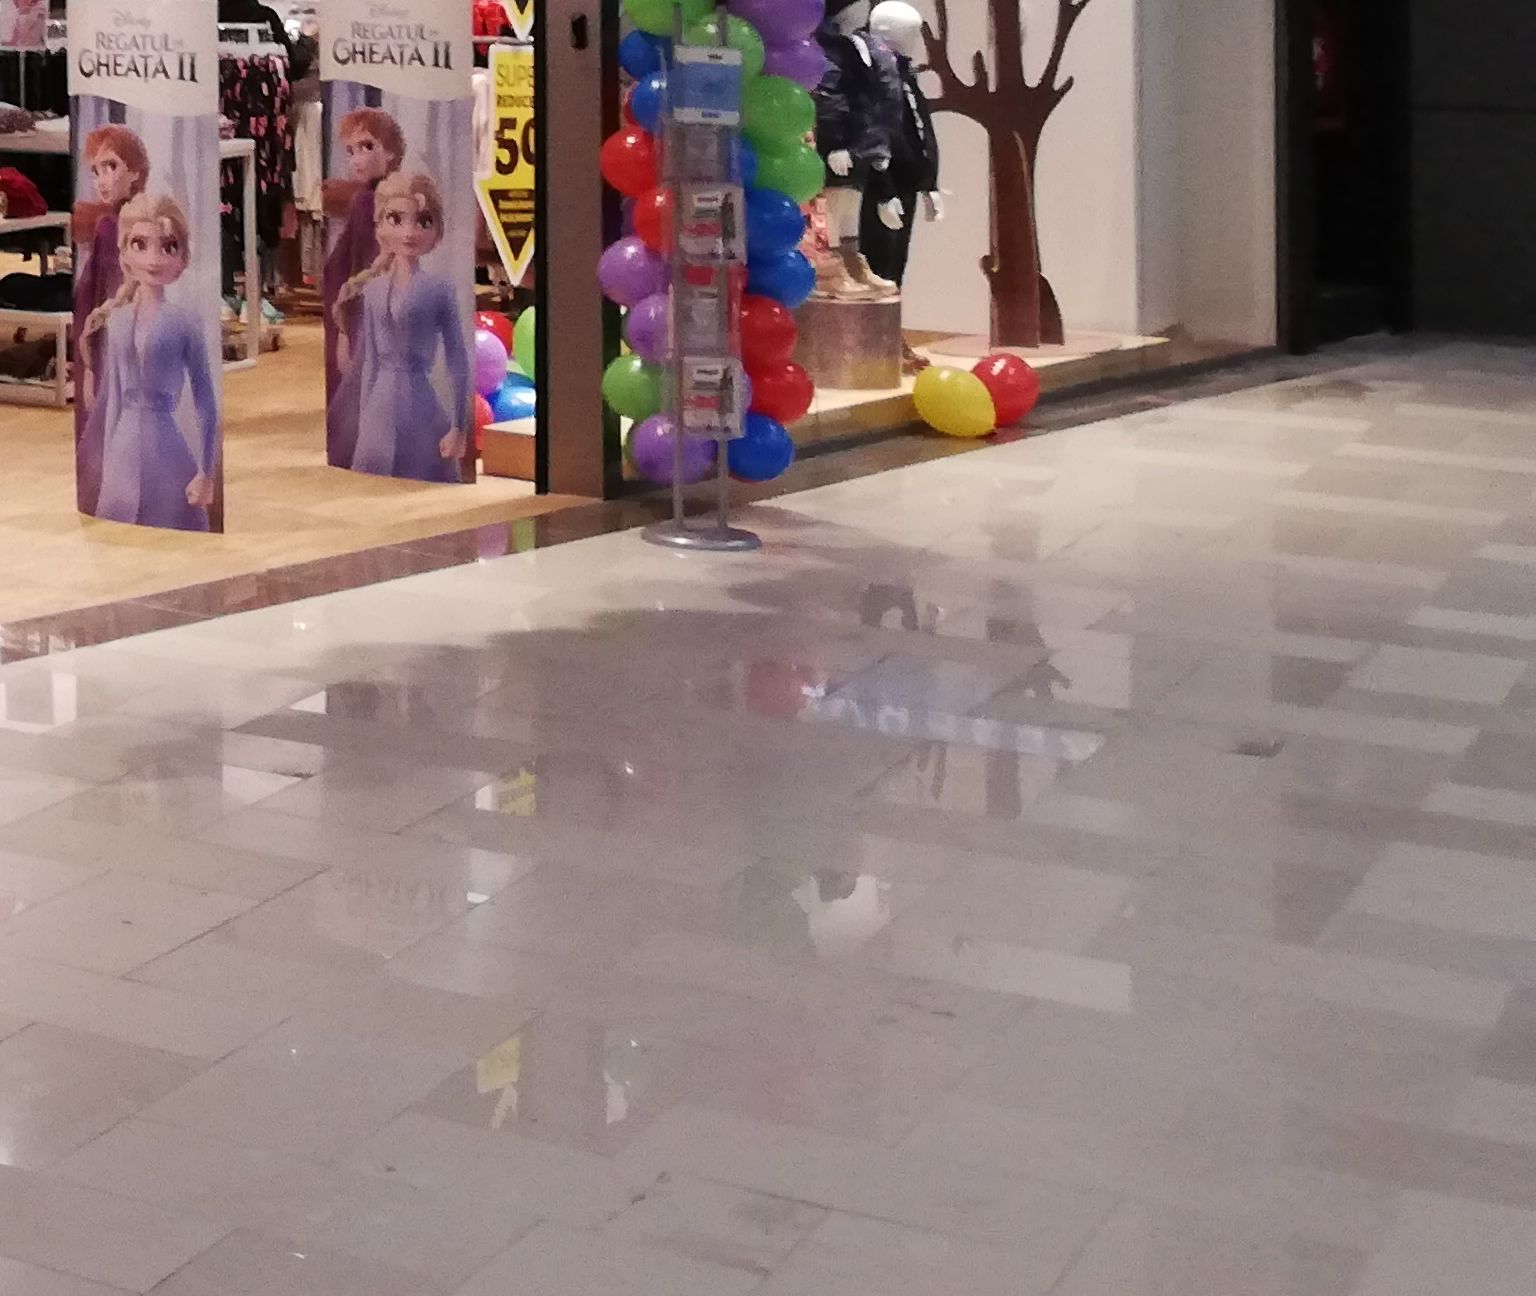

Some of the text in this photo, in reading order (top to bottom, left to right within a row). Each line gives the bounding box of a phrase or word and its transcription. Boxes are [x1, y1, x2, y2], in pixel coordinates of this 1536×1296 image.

[95, 30, 174, 52] REGATUL
[431, 40, 454, 70] II
[177, 51, 199, 83] II
